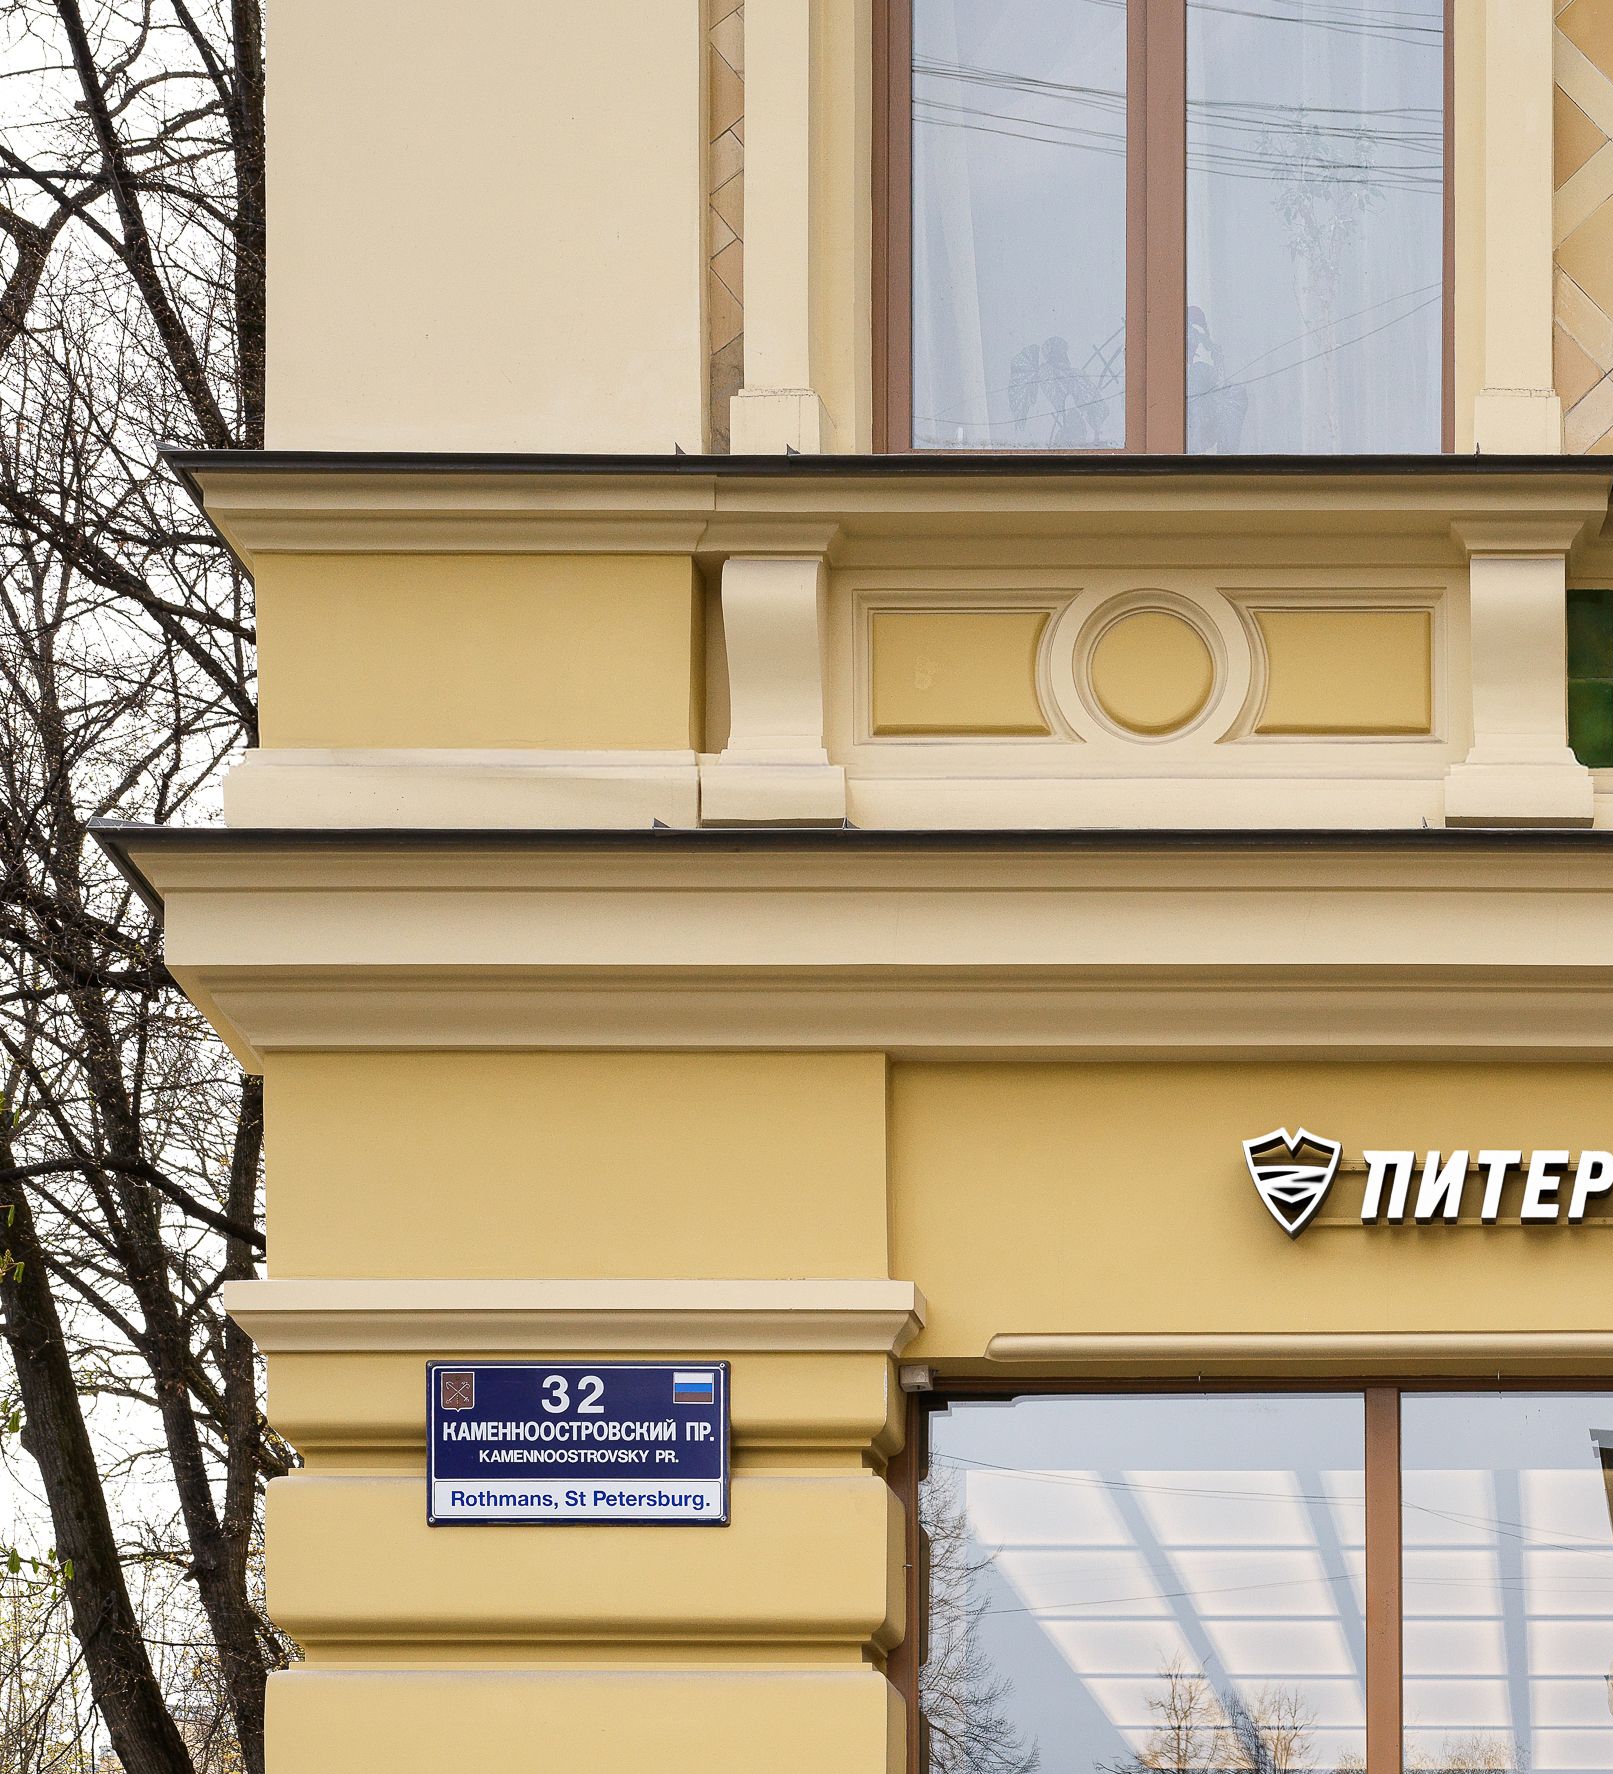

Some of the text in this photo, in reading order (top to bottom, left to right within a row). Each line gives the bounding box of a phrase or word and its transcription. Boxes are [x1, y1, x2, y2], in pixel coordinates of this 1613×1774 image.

[541, 1374, 605, 1414] 32
[442, 1418, 715, 1441] КАМЕННООСТРОВСКИЙ ПР.
[478, 1449, 679, 1463] KAMENNOOSTROVSKY PR.
[450, 1490, 711, 1510] Rothmans, St Petersburg.
